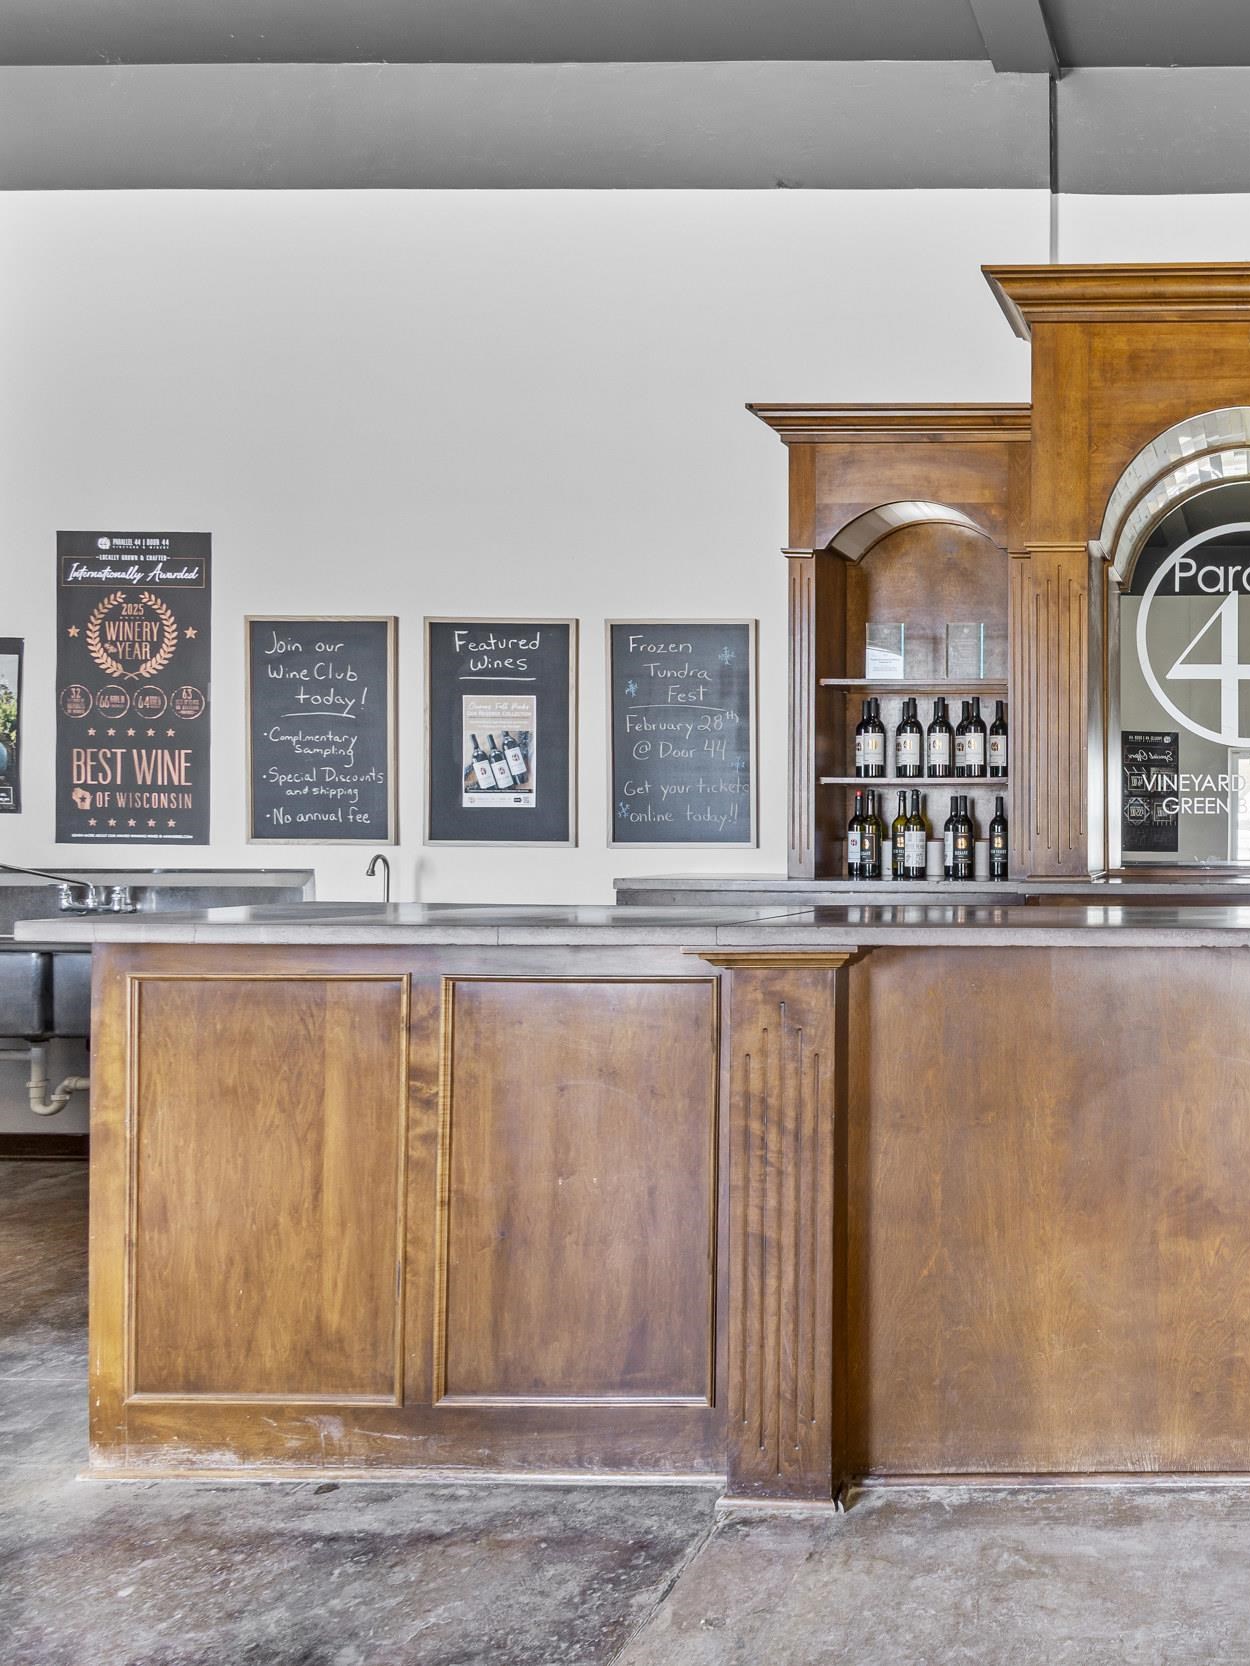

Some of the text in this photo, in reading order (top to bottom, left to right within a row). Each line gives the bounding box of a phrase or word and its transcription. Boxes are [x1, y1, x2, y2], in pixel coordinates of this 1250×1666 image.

[67, 562, 199, 584] Internationally Awarded
[121, 603, 145, 616] 2025
[105, 621, 160, 642] WINERY
[454, 630, 540, 653] Featured
[116, 641, 151, 660] YEAR
[264, 630, 345, 654] Join our
[628, 634, 693, 654] Frozen
[268, 662, 358, 682] Wine Club
[641, 662, 713, 681] Tundra
[294, 685, 368, 716] today!
[667, 684, 709, 703] Fest
[626, 714, 693, 740] February
[632, 739, 727, 760] @ Door 44
[72, 748, 193, 786] BEST WINE
[268, 766, 385, 786] Special Discounts
[623, 779, 652, 796] Get
[660, 783, 692, 801] your
[1142, 774, 1247, 792] VINEYARD
[96, 791, 193, 809] OF WISCONSIN
[285, 785, 359, 804] and shipping
[273, 806, 371, 825] No annual fee
[629, 803, 674, 823] online
[1162, 797, 1229, 815] GREEN
